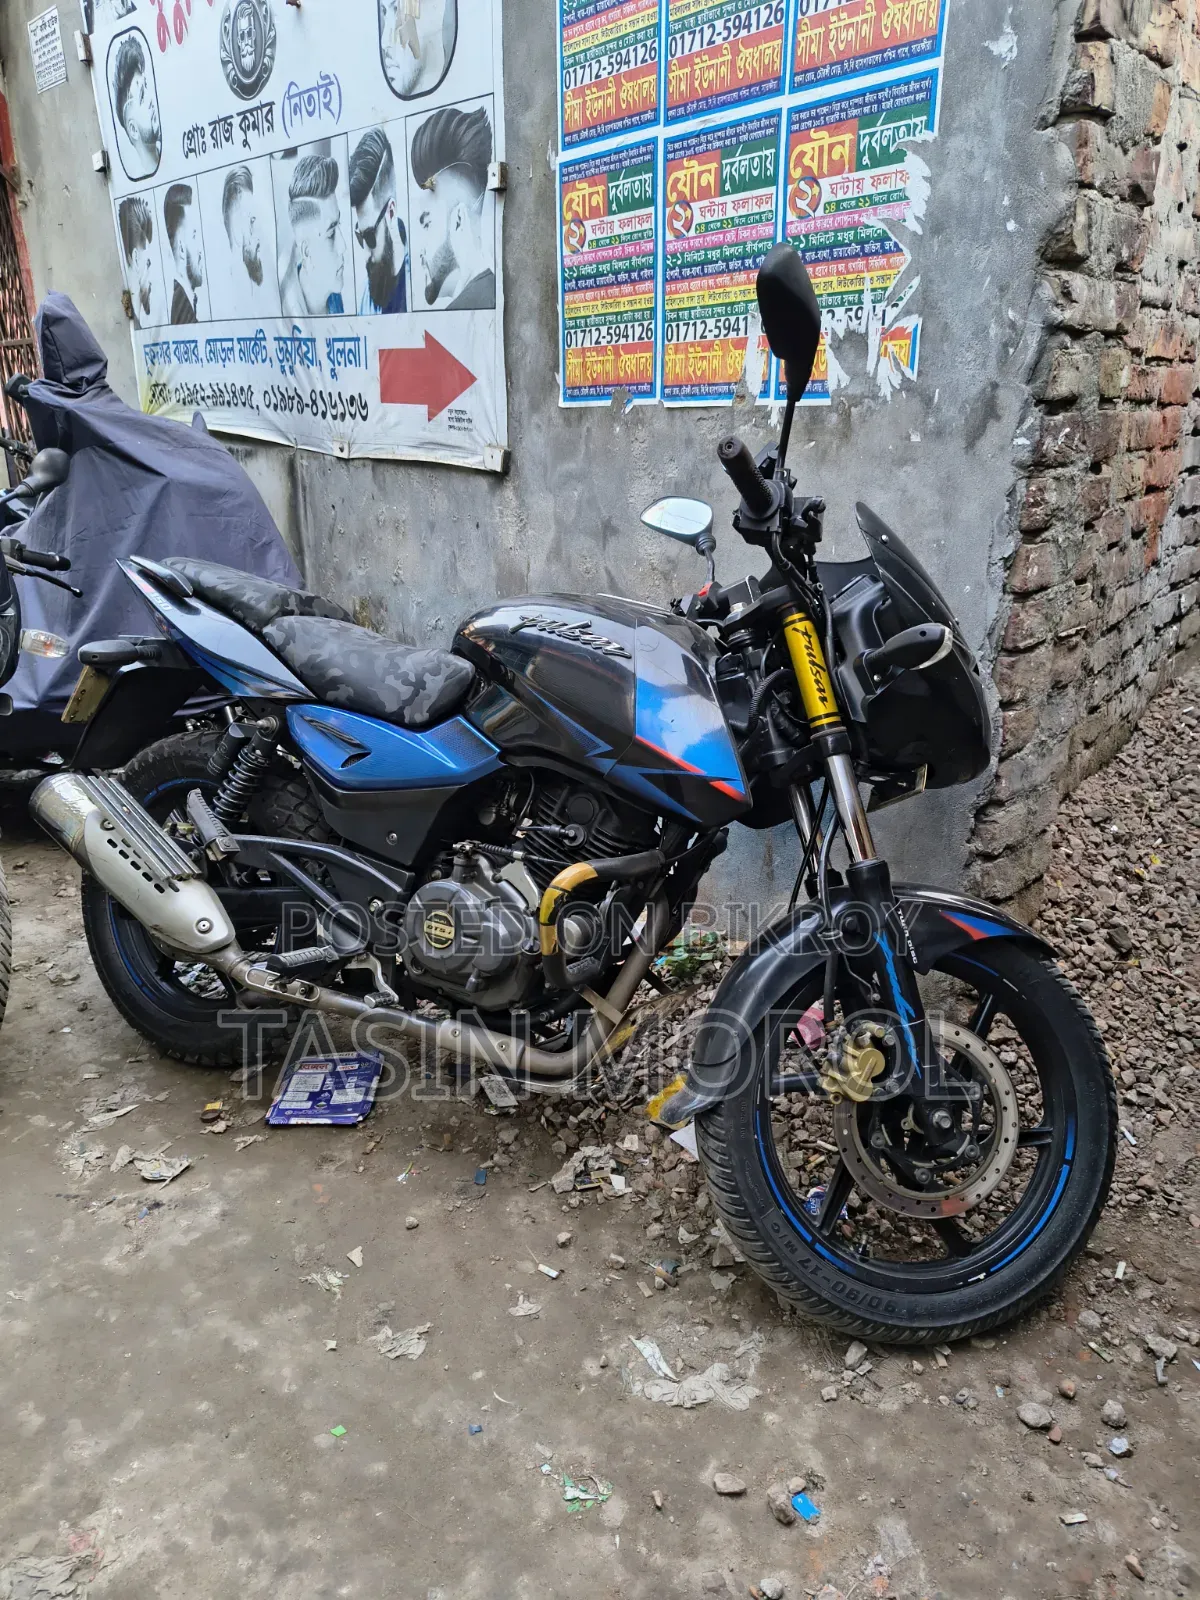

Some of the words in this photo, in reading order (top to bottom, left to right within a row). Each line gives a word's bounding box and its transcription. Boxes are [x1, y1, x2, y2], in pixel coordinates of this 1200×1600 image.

[668, 0, 784, 58] 01712-594126
[796, 18, 825, 66] সীমা
[829, 0, 876, 60] ইউনানী
[563, 39, 657, 90] 01712-594126
[668, 59, 691, 100] সীমা
[693, 42, 732, 96] ইউনানী
[736, 38, 782, 79] ঔষধালয়
[208, 115, 234, 150] রাজ
[236, 100, 276, 151] কুমার
[282, 71, 342, 138] (নিতাই)
[563, 85, 583, 127] সীমা
[584, 74, 616, 122] ইউনানী
[620, 73, 657, 109] ঔষধালয়
[666, 158, 719, 202] যৌন
[722, 144, 775, 192] দুর্বলতায়
[790, 128, 855, 179] যৌন
[563, 180, 605, 220] যৌন
[607, 169, 652, 212] দুর্বলতায়
[730, 193, 773, 219] ফলাফল
[824, 202, 836, 214] ১৪
[840, 200, 856, 209] থেকে
[857, 197, 870, 209] ২১
[618, 213, 652, 230] ফলাফল
[695, 224, 705, 234] ১৪
[722, 217, 732, 230] ২১
[566, 318, 653, 348] 01712-594126
[566, 347, 582, 382] সীমা
[585, 346, 614, 382] ইউনানী
[617, 340, 652, 378] ঔষধালয়
[665, 342, 686, 380] সীমা
[688, 338, 724, 381] ইউনানী
